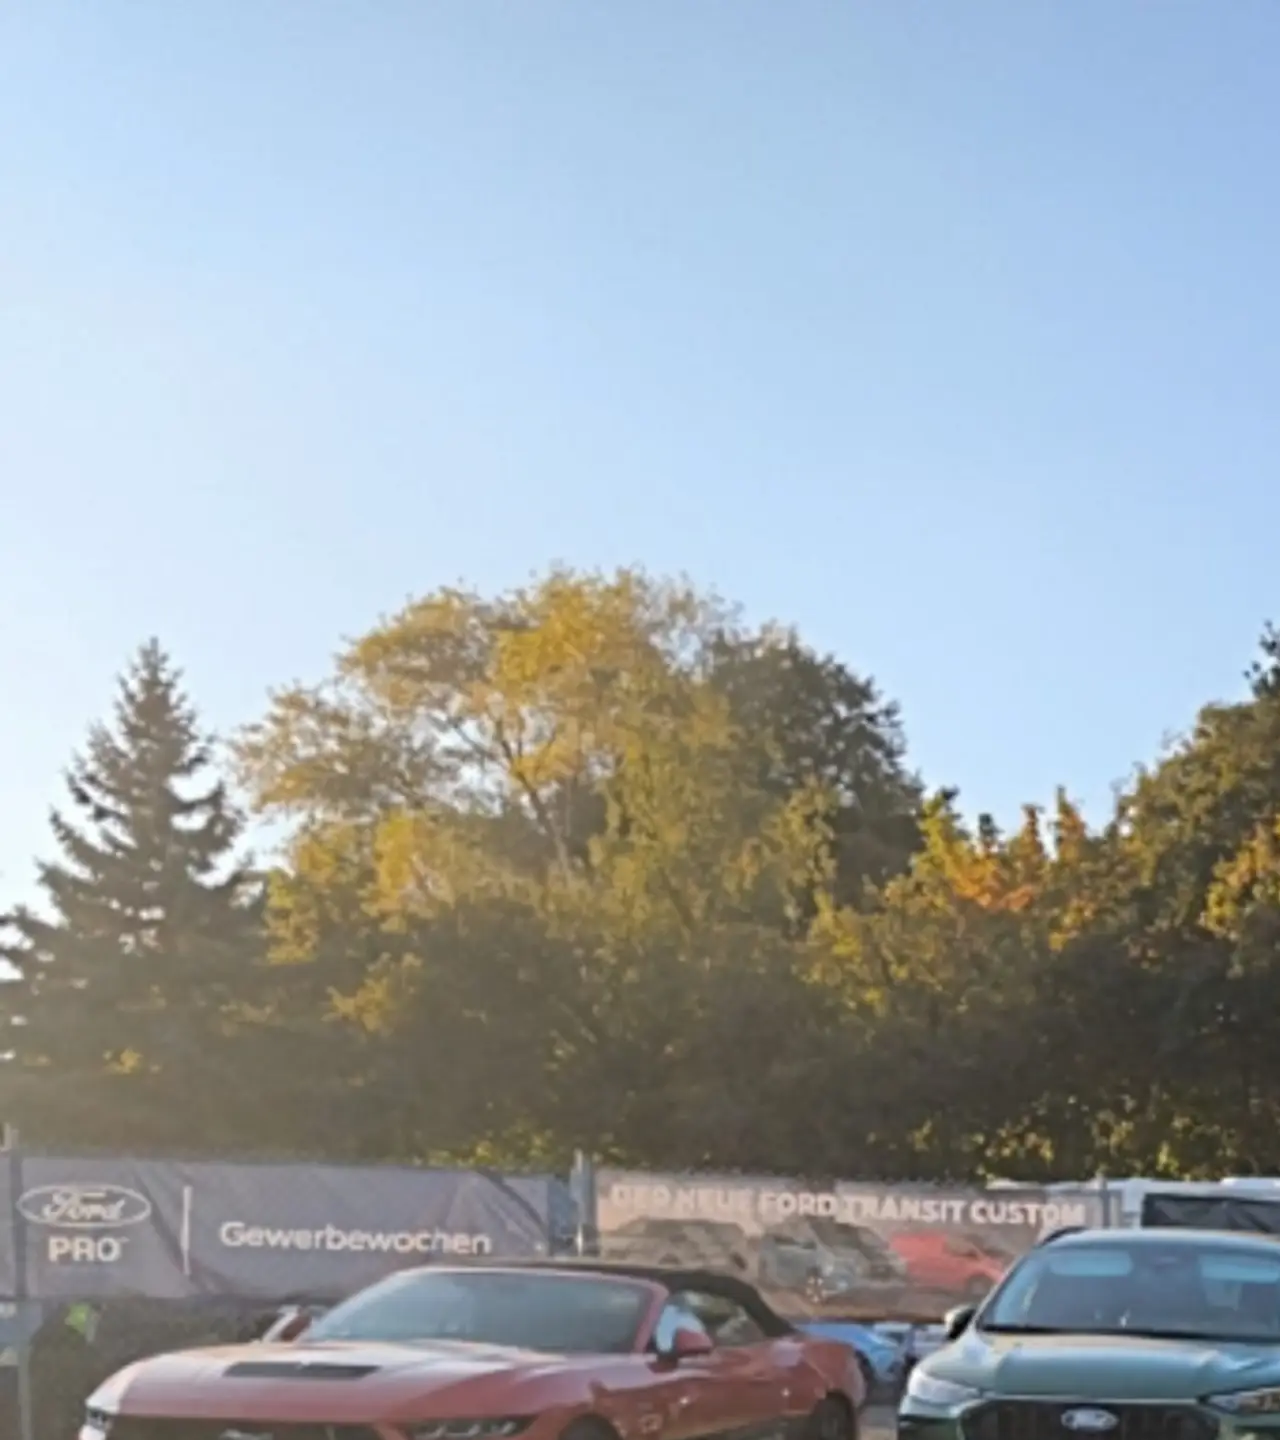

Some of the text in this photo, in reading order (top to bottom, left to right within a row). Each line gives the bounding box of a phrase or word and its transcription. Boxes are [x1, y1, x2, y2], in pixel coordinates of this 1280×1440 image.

[42, 1190, 126, 1221] Ford
[758, 1191, 838, 1217] FORD
[843, 1195, 966, 1223] TRANSIT
[969, 1203, 1087, 1226] CUSTOM
[48, 1235, 121, 1263] PRO
[219, 1221, 492, 1254] Gewerbewochen
